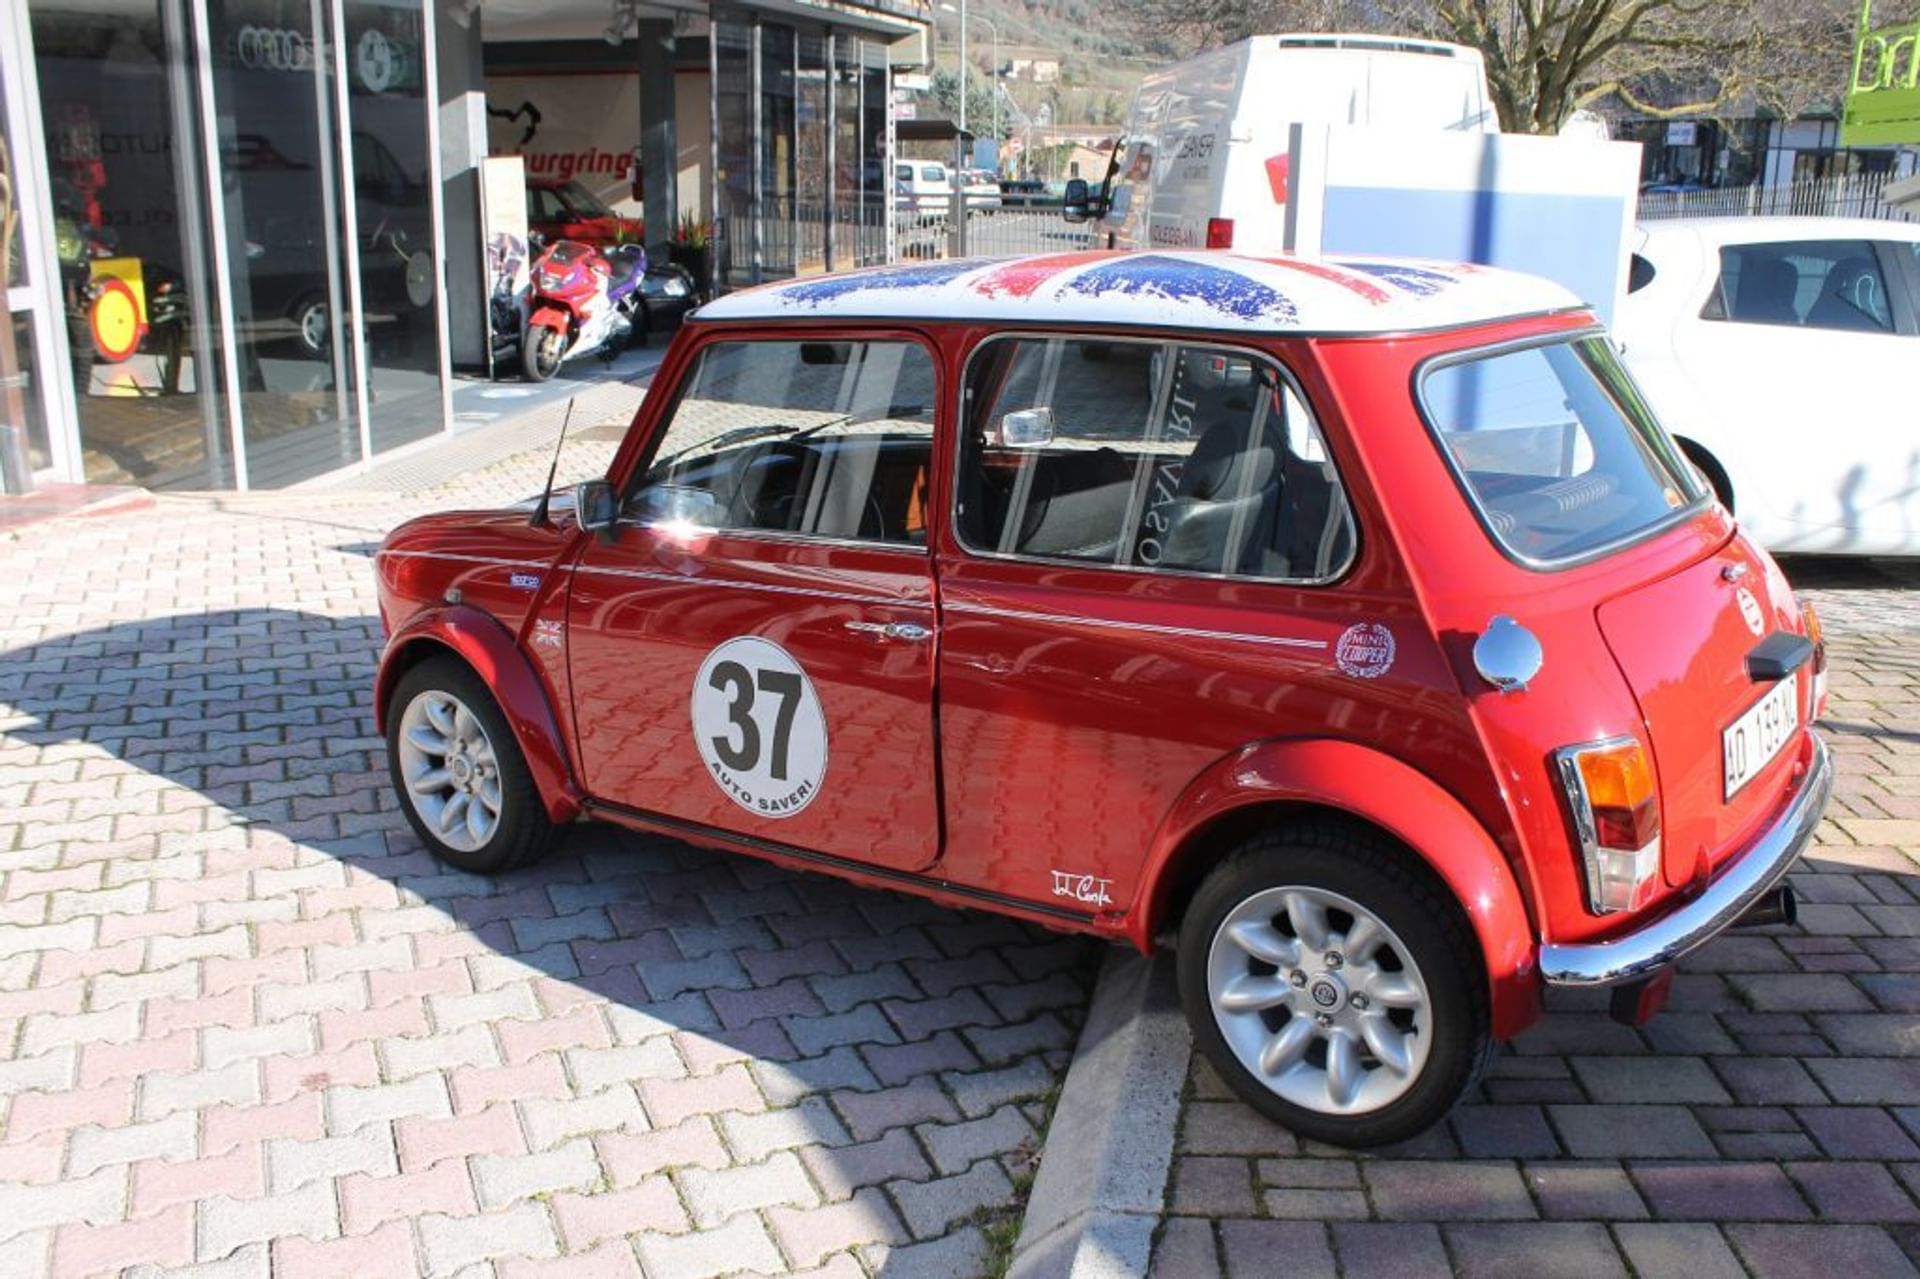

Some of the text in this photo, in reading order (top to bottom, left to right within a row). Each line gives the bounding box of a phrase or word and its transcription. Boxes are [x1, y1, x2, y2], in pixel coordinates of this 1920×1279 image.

[1342, 645, 1387, 664] COOPER
[1350, 633, 1384, 647] MINI
[709, 660, 802, 781] 37
[711, 762, 813, 811] AUTO SAVERI
